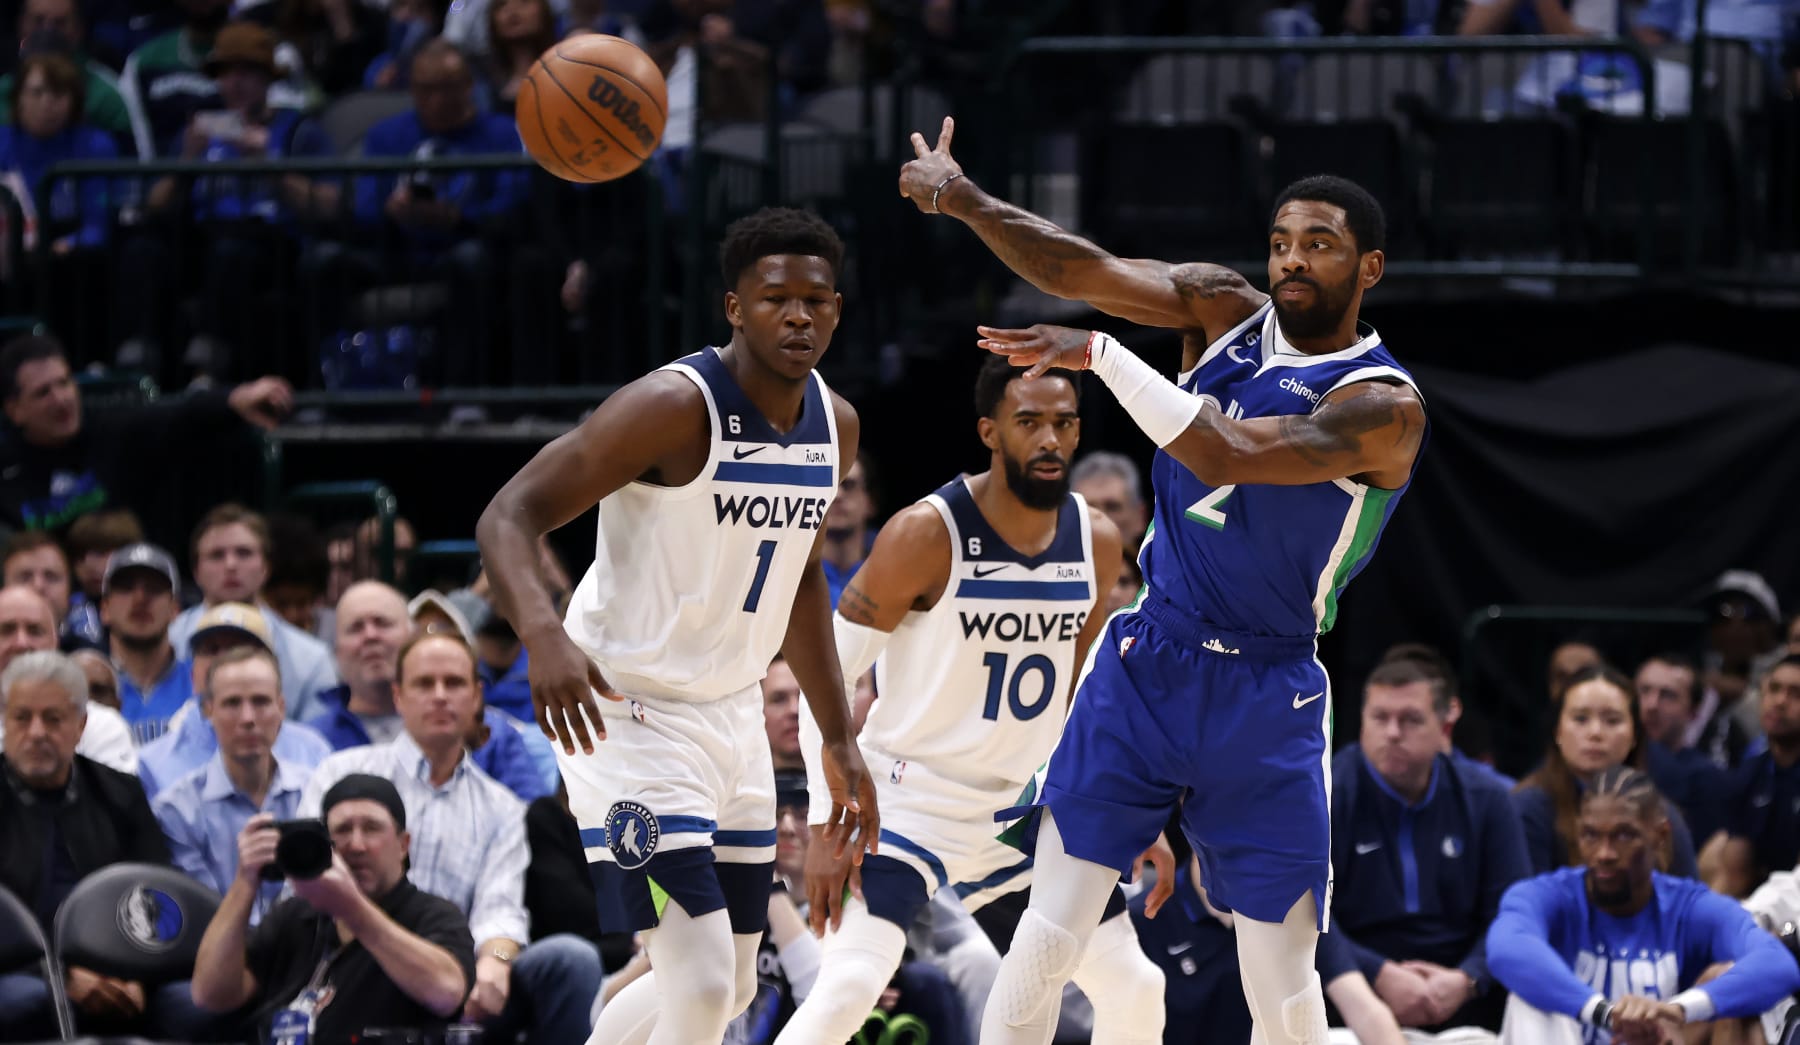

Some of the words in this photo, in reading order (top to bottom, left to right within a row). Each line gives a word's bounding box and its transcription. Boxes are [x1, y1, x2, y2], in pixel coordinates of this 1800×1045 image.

[588, 74, 655, 146] Wilson
[1279, 377, 1320, 404] chime
[728, 414, 741, 435] 6
[713, 493, 826, 530] WOLVES
[968, 537, 982, 556] 6
[742, 540, 778, 613] 1
[959, 612, 1086, 642] WOLVES
[982, 651, 1056, 722] 10
[622, 803, 657, 853] TIMBERWOLVES
